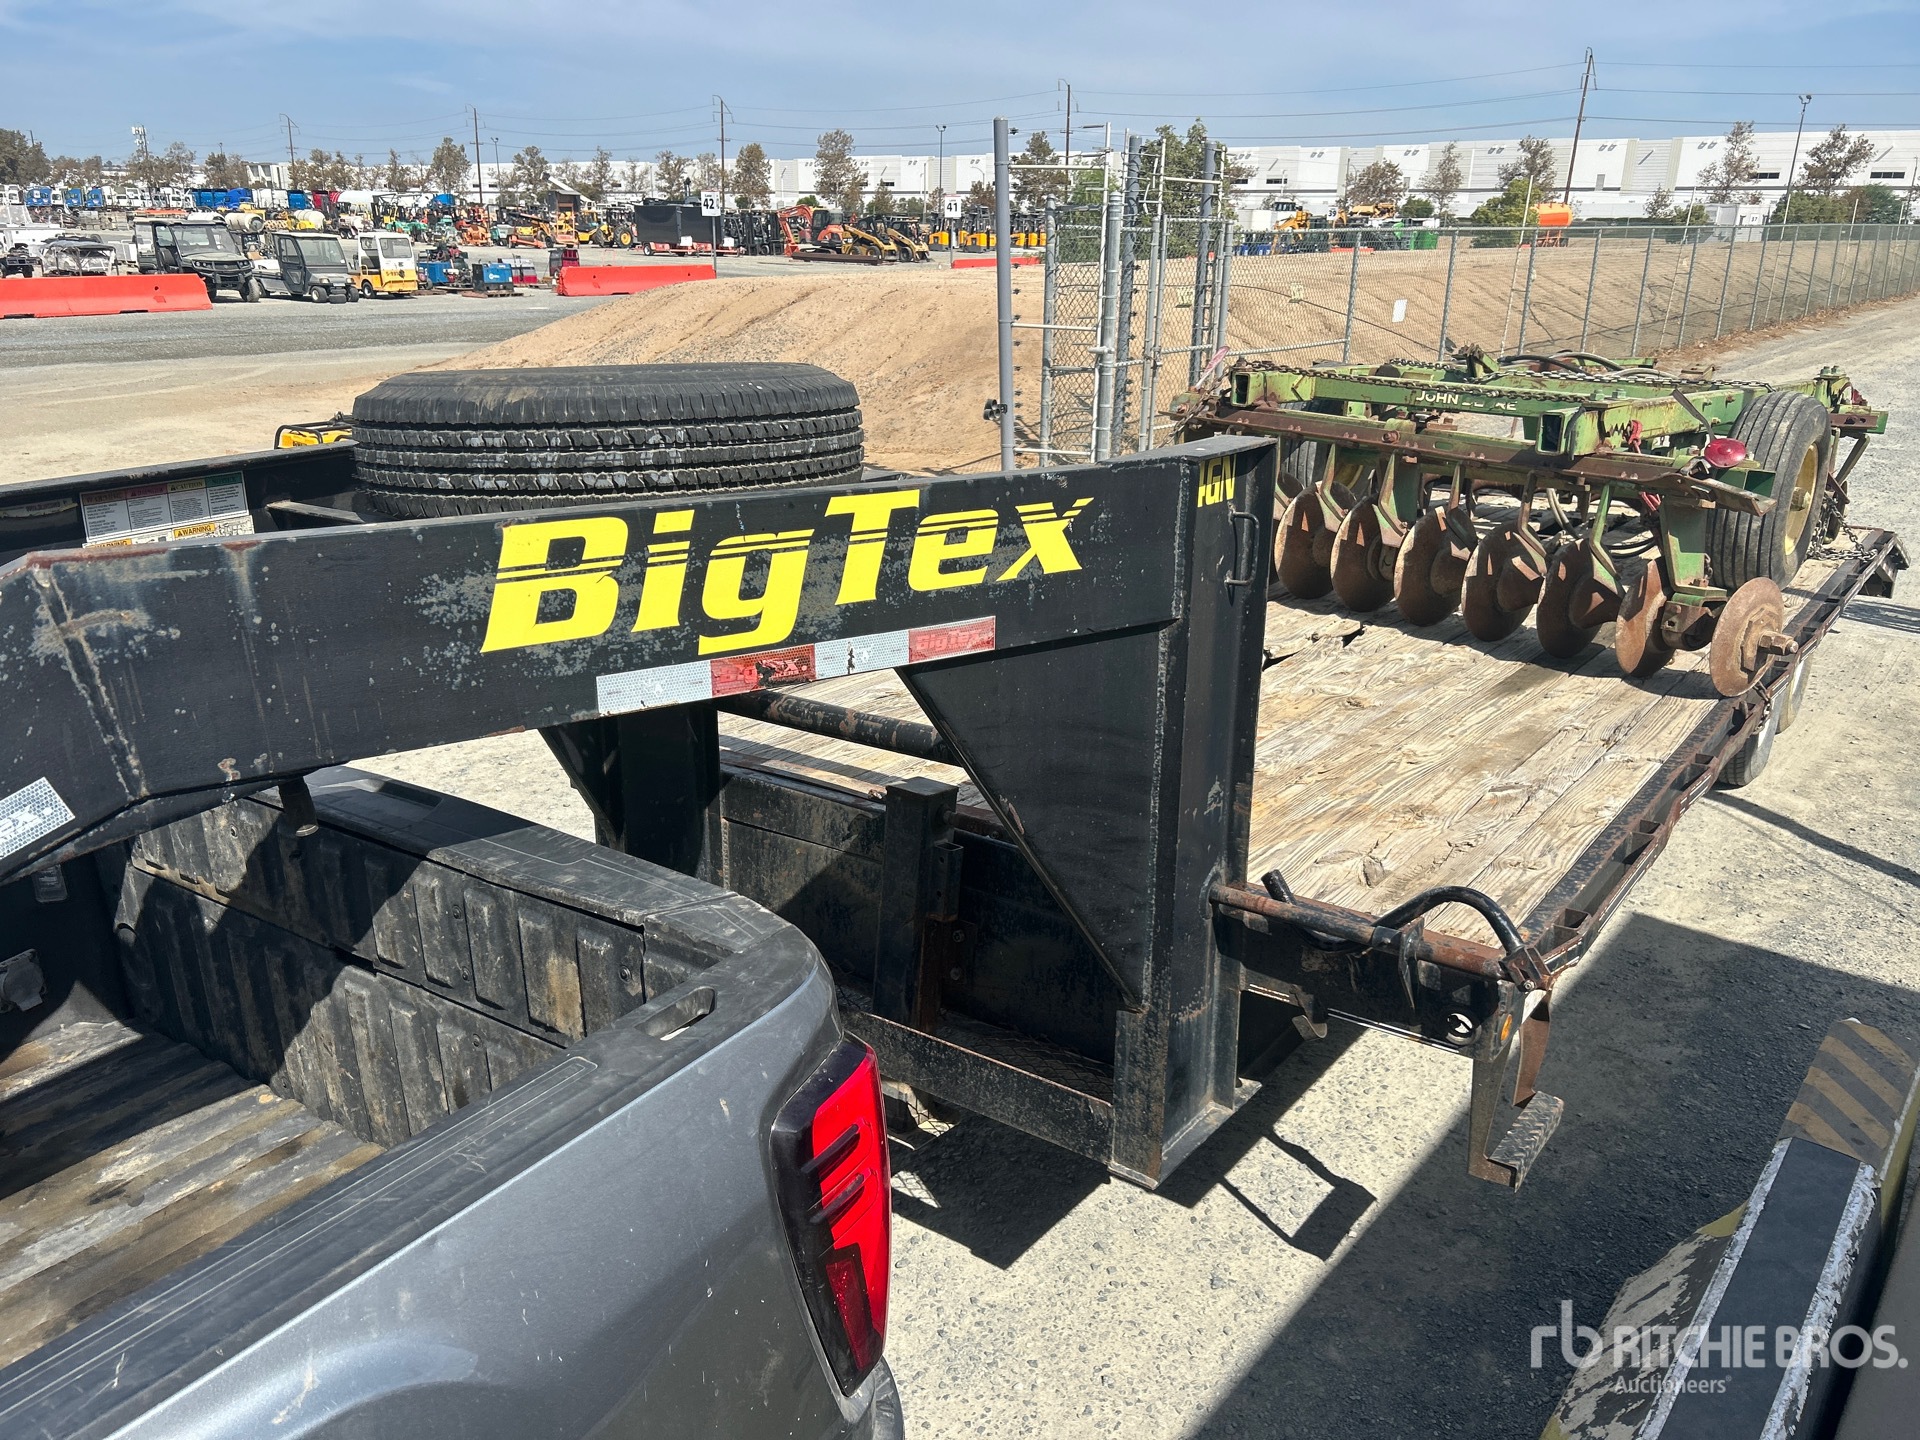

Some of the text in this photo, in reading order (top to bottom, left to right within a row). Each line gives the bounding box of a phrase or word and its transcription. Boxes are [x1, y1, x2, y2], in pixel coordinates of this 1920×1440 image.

[703, 198, 714, 209] 42
[946, 202, 957, 212] 41
[1416, 390, 1459, 405] JOHN
[176, 481, 203, 491] CAUTION
[182, 524, 212, 535] WARNING
[483, 489, 1093, 655] BigTex
